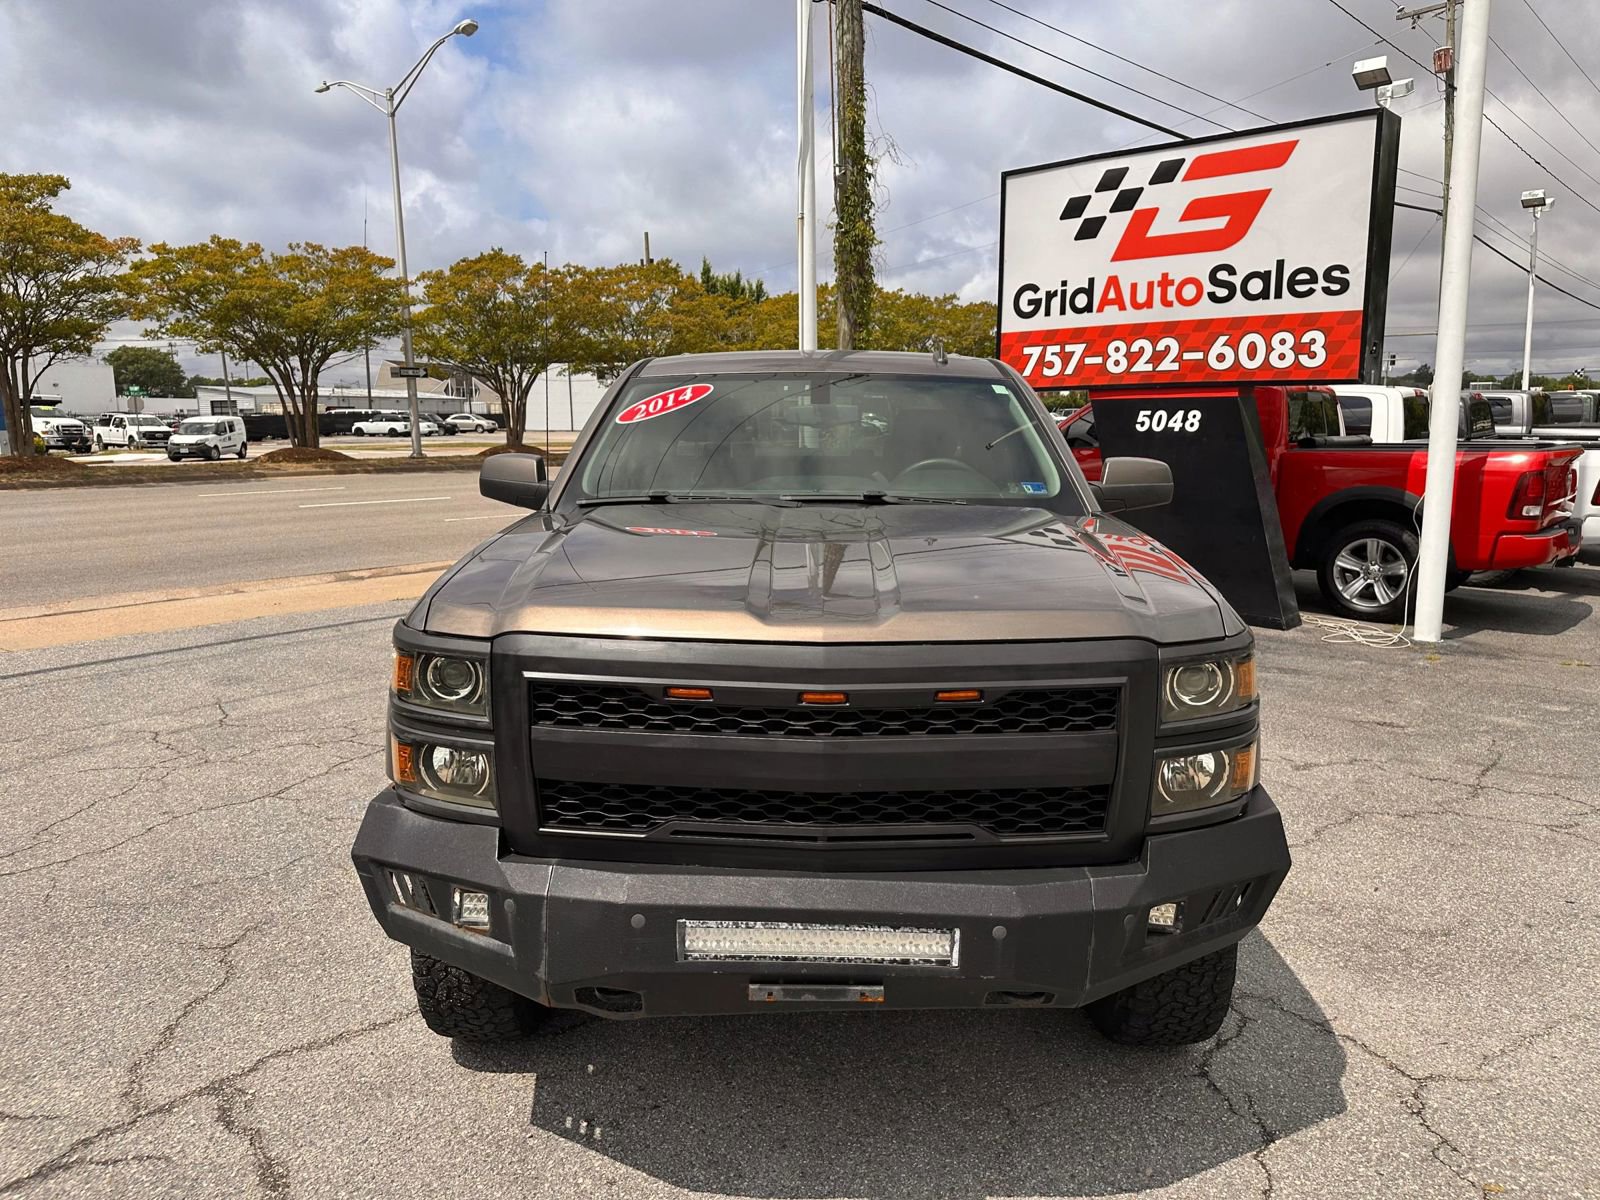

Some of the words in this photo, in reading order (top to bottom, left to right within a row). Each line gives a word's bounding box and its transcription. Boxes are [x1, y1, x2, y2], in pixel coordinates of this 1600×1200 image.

[1013, 259, 1351, 320] GridAutoSales
[1022, 330, 1327, 377] 757-822-6083
[634, 386, 693, 420] 2014
[1135, 409, 1202, 433] 5048
